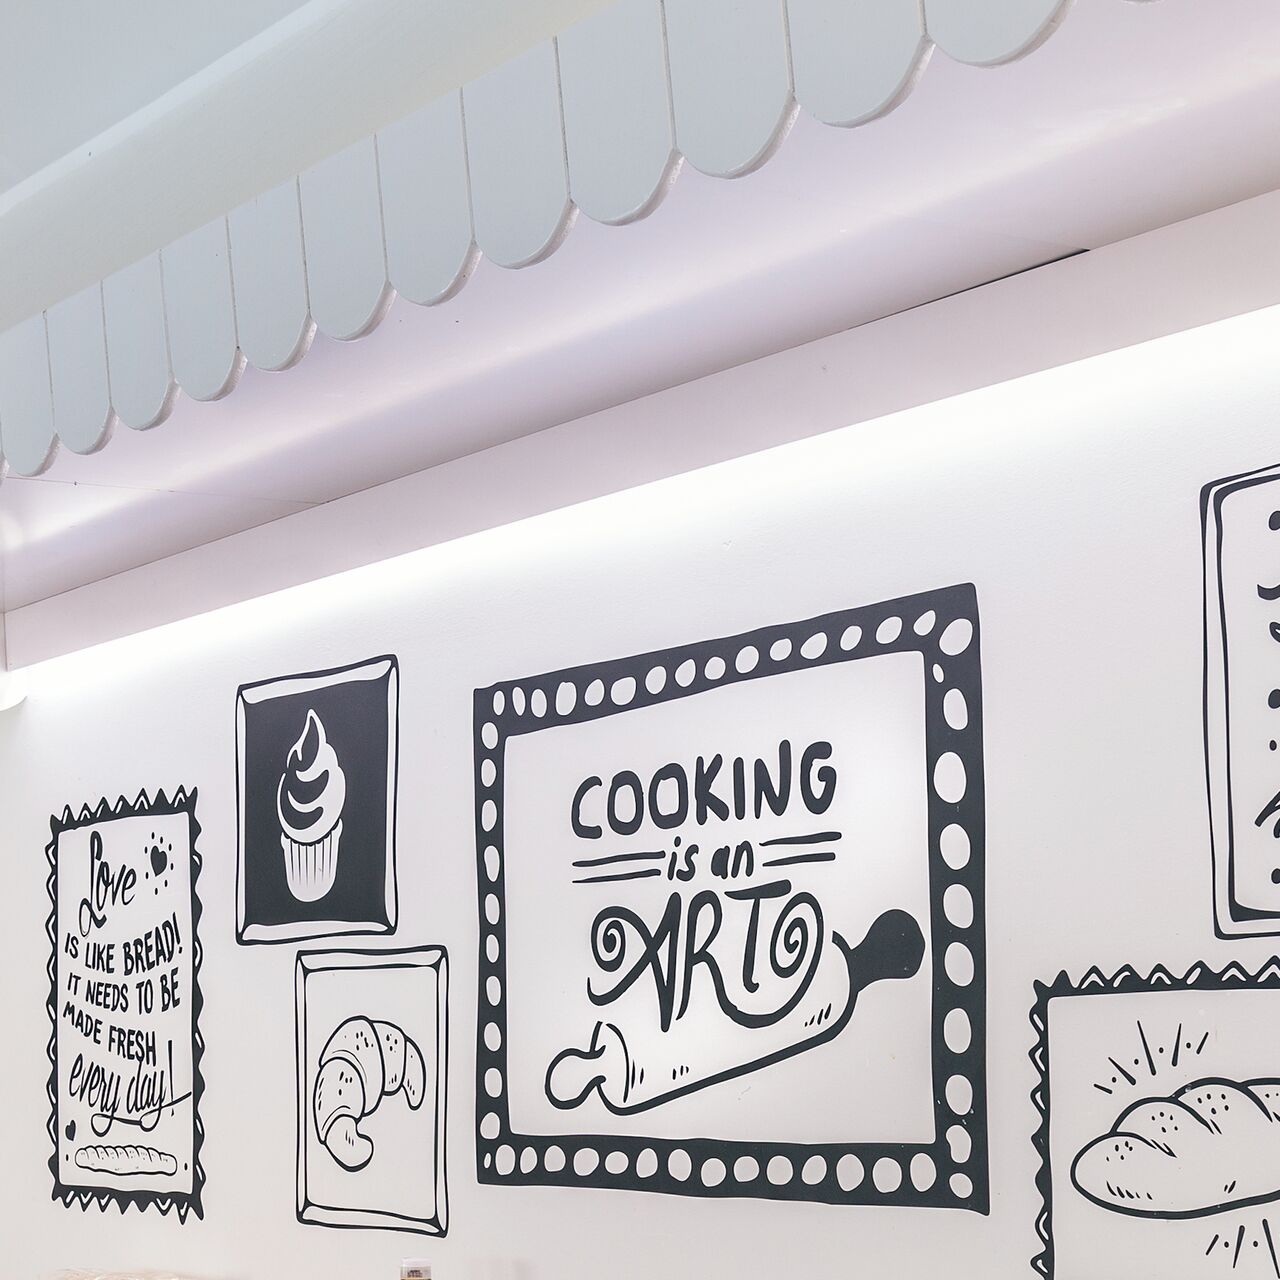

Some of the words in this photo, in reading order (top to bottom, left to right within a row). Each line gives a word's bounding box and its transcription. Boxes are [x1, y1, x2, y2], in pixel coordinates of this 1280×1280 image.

[571, 739, 837, 840] COOKING
[78, 830, 137, 938] Love
[667, 835, 700, 882] is
[710, 840, 755, 880] an
[64, 932, 79, 959] IS
[84, 942, 116, 974] LIKE
[122, 911, 184, 977] BREAD!
[586, 879, 825, 1033] ART
[67, 972, 82, 996] IT
[85, 979, 129, 1014] NEEDS
[135, 978, 154, 1015] TO
[159, 966, 181, 1013] BE
[62, 1000, 104, 1045] MADE
[108, 1024, 157, 1067] FRESH
[68, 1052, 122, 1136] every
